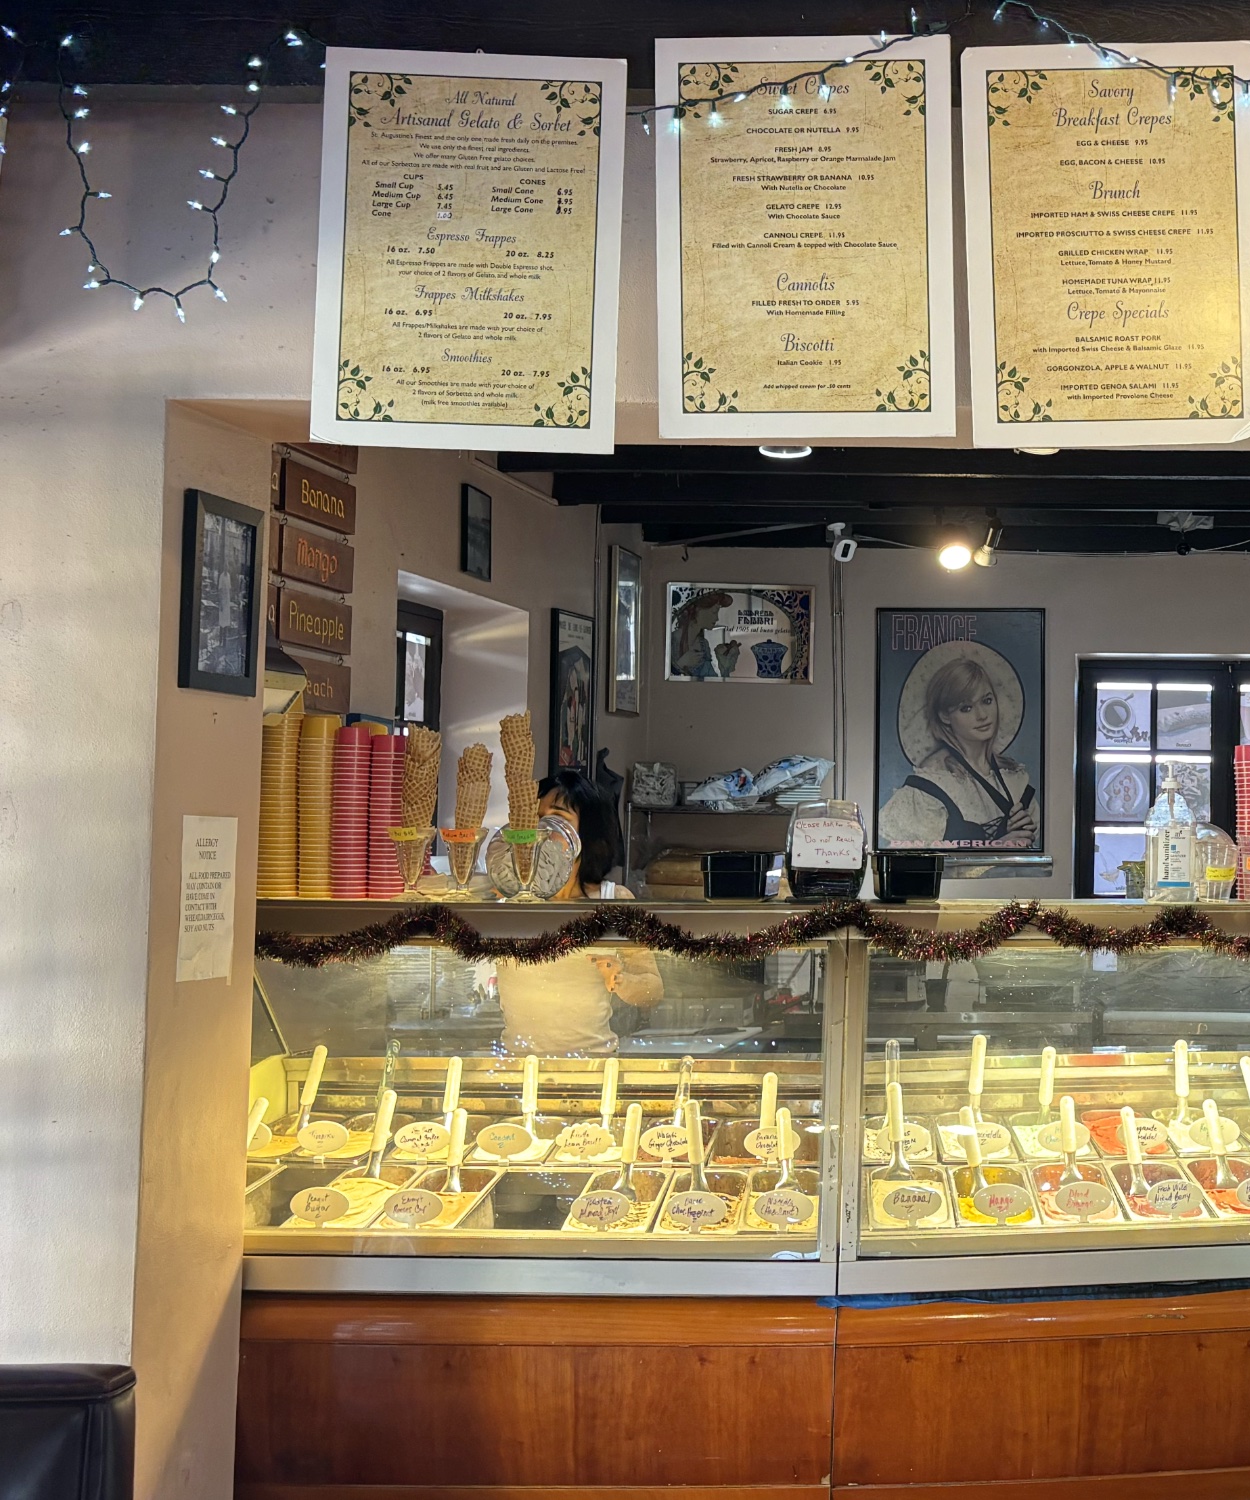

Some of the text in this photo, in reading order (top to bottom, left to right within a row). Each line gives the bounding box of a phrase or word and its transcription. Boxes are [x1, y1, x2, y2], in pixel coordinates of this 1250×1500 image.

[445, 90, 517, 106] All Natural
[1088, 79, 1134, 105] Savory
[380, 108, 571, 132] Artisanal Gelato & Sorbet
[1052, 107, 1172, 132] Breakfast Crepes
[372, 190, 403, 198] Medium
[406, 192, 421, 201] Cup
[399, 182, 414, 191] Cup
[1089, 180, 1140, 199] Brunch
[427, 226, 517, 249] Espresso Frappes
[387, 245, 396, 253] 16
[537, 251, 554, 259] 8.25
[777, 273, 835, 291] Cannolis
[415, 285, 525, 306] Frappes Milkshakes
[1067, 299, 1169, 327] Crepe Specials
[780, 333, 835, 352] Biscotti
[441, 348, 492, 363] Smoothies
[301, 479, 345, 519] Banana
[297, 537, 338, 583] Mango
[289, 600, 344, 645] Pineapple
[891, 614, 977, 650] FRANCE
[195, 838, 219, 847] ALLERGY
[804, 835, 816, 843] Do
[889, 840, 1028, 848] PAN AMERICAN
[198, 851, 217, 860] NOTICE
[814, 848, 850, 857] Thanks
[1162, 830, 1170, 880] hand sanitizer
